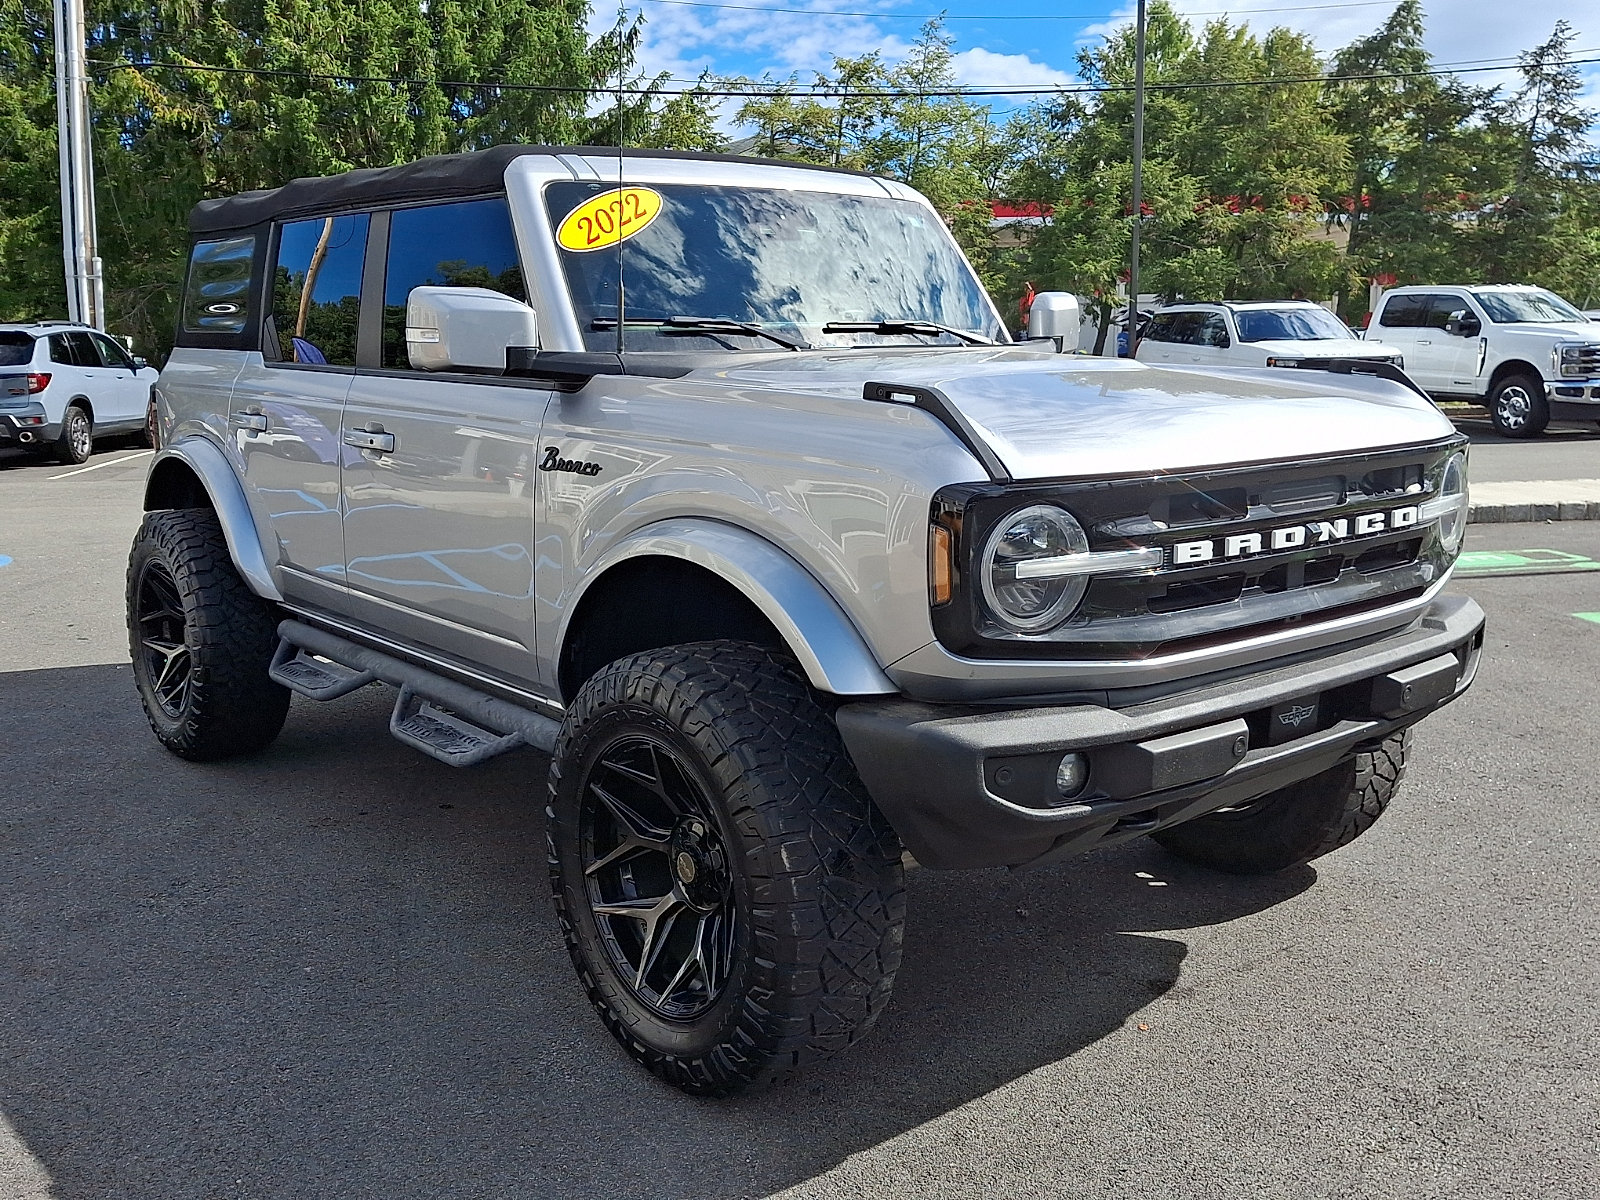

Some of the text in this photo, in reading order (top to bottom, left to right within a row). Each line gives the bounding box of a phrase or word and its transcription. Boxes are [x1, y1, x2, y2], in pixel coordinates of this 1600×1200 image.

[578, 194, 646, 245] 2022
[539, 446, 603, 476] Bronco
[1173, 506, 1418, 564] BRONCO
